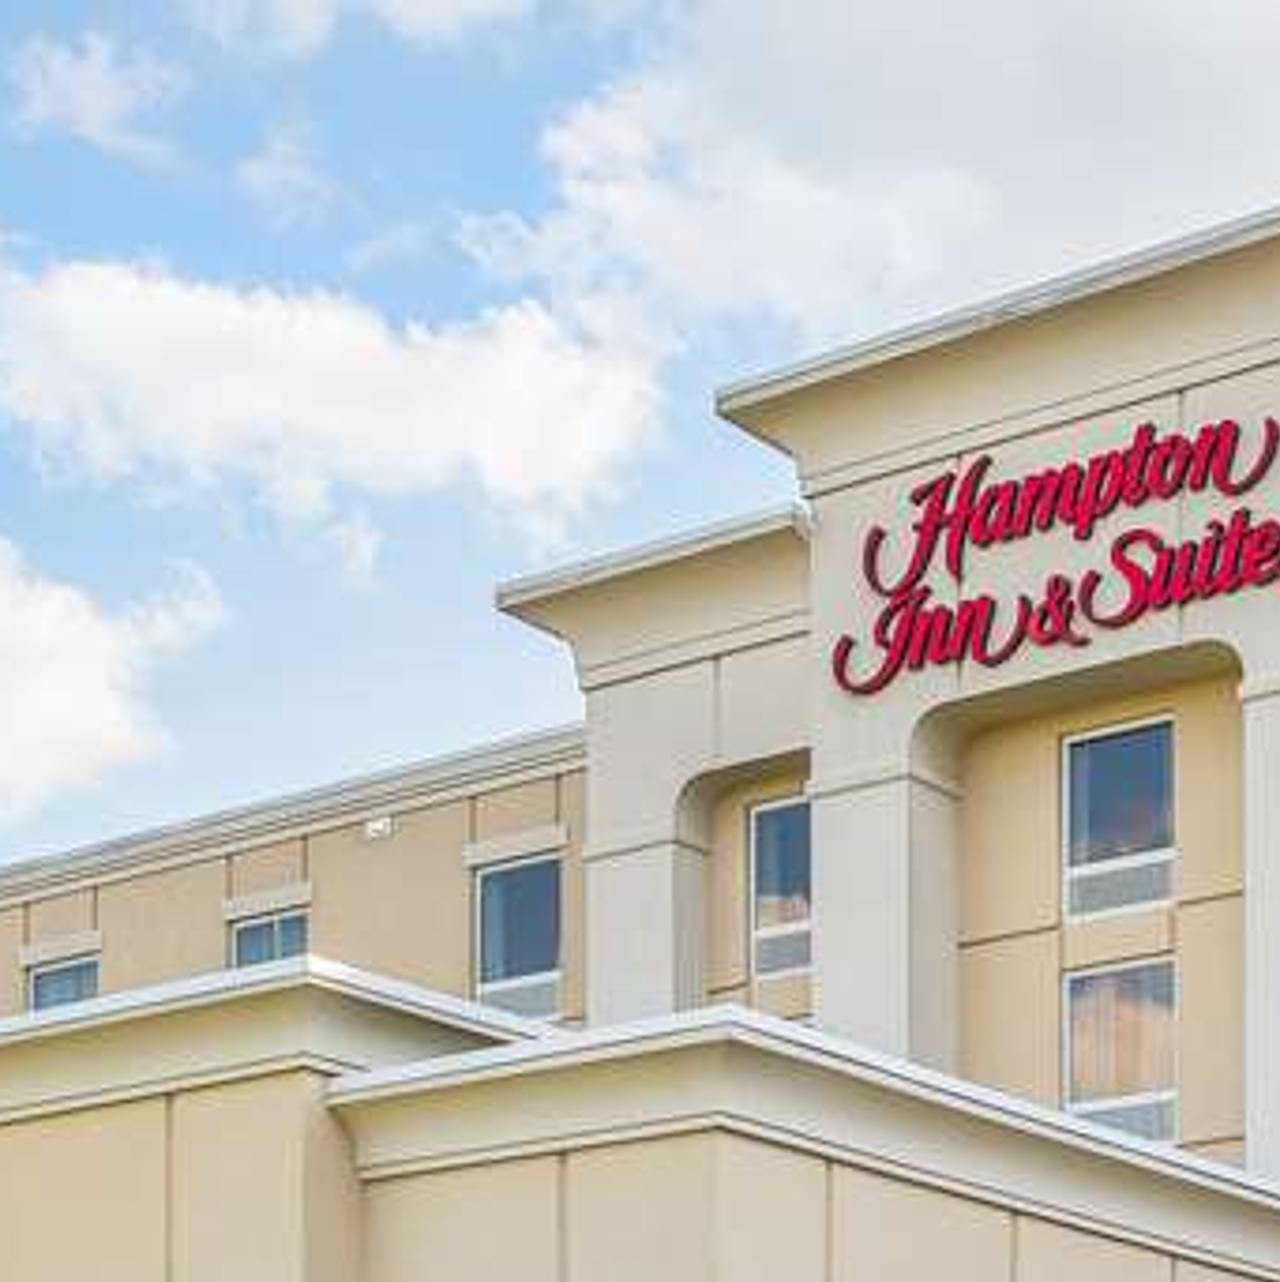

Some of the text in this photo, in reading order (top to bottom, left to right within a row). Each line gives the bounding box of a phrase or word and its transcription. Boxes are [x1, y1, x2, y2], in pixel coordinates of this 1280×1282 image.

[863, 417, 1280, 597] Hampton
[833, 585, 1030, 694] Inn
[1028, 575, 1091, 646] &
